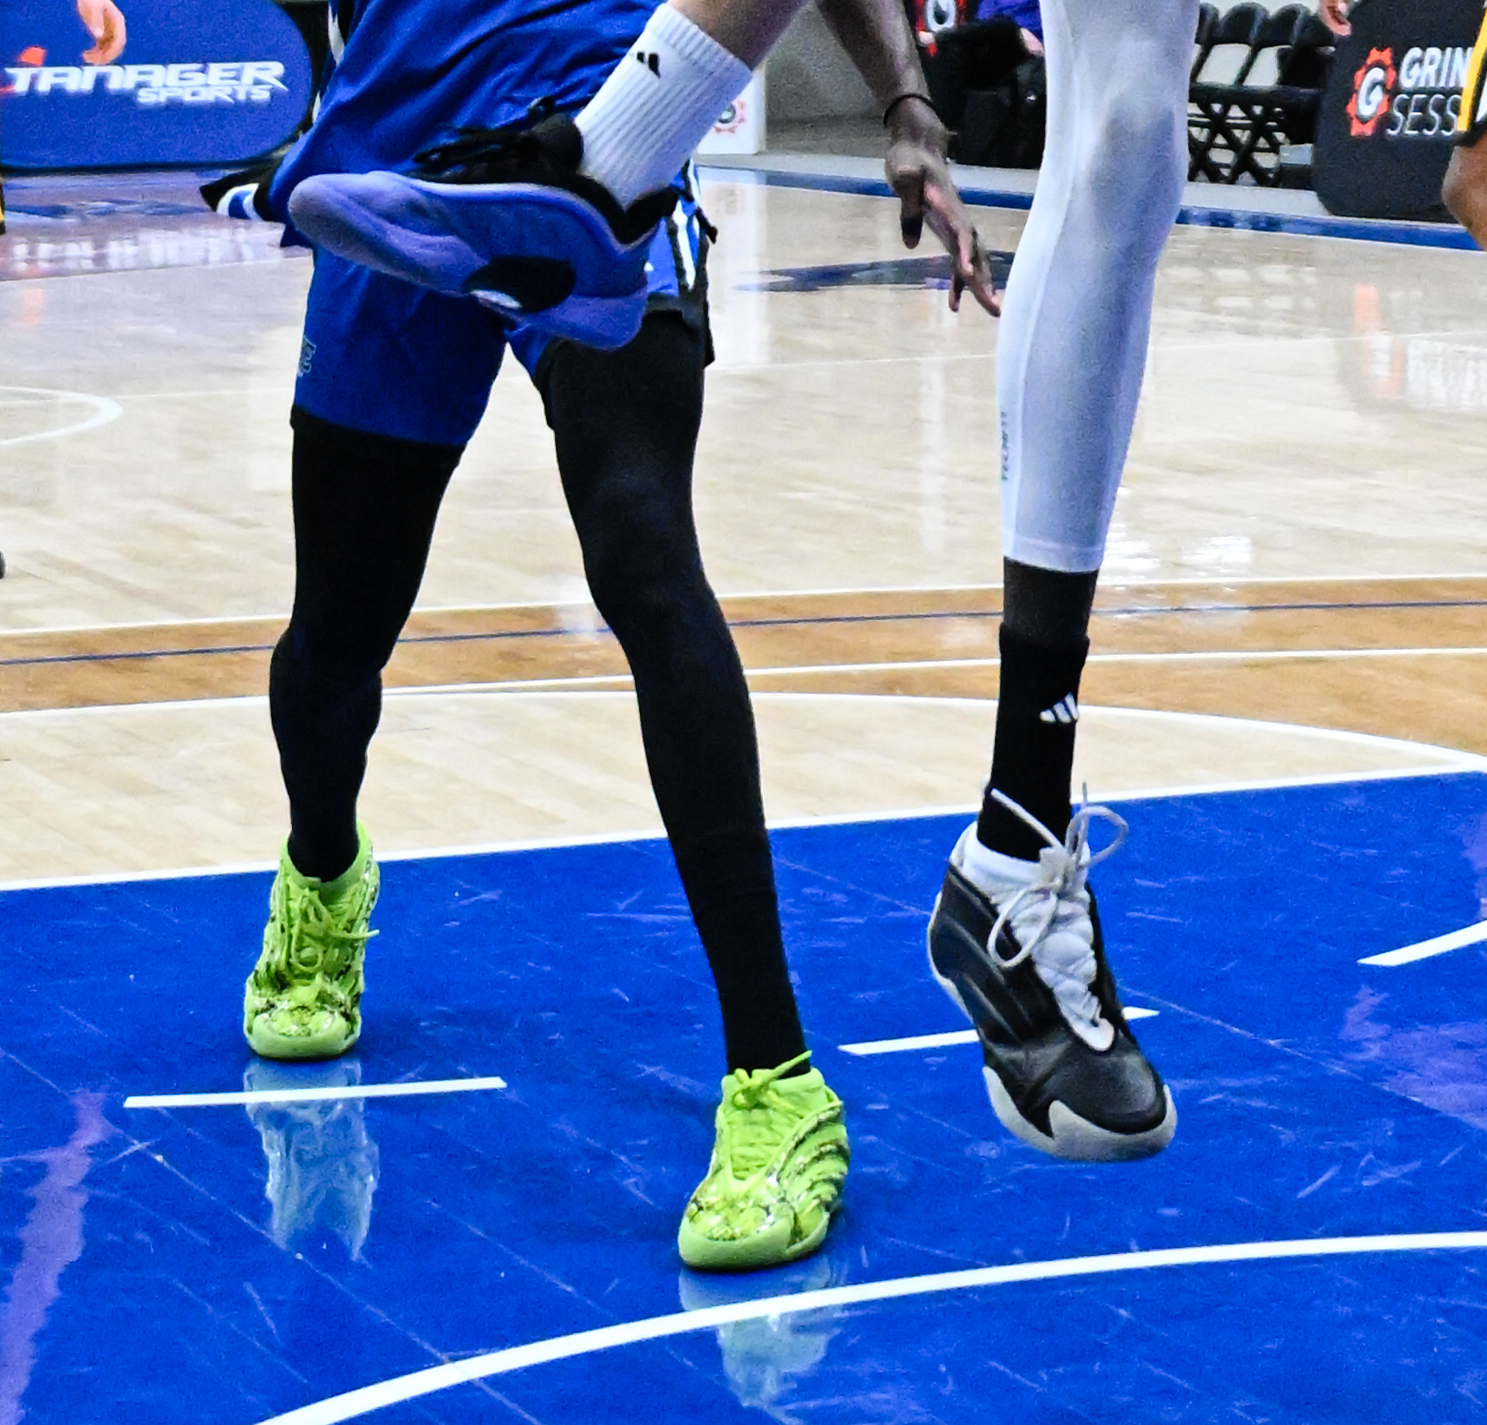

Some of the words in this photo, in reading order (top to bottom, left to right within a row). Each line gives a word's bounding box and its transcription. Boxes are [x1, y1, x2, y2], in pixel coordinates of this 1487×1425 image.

[4, 60, 289, 96] TANAGER
[1399, 47, 1474, 88] GRIN
[136, 85, 274, 105] SPORTS
[1386, 94, 1462, 136] SESS
